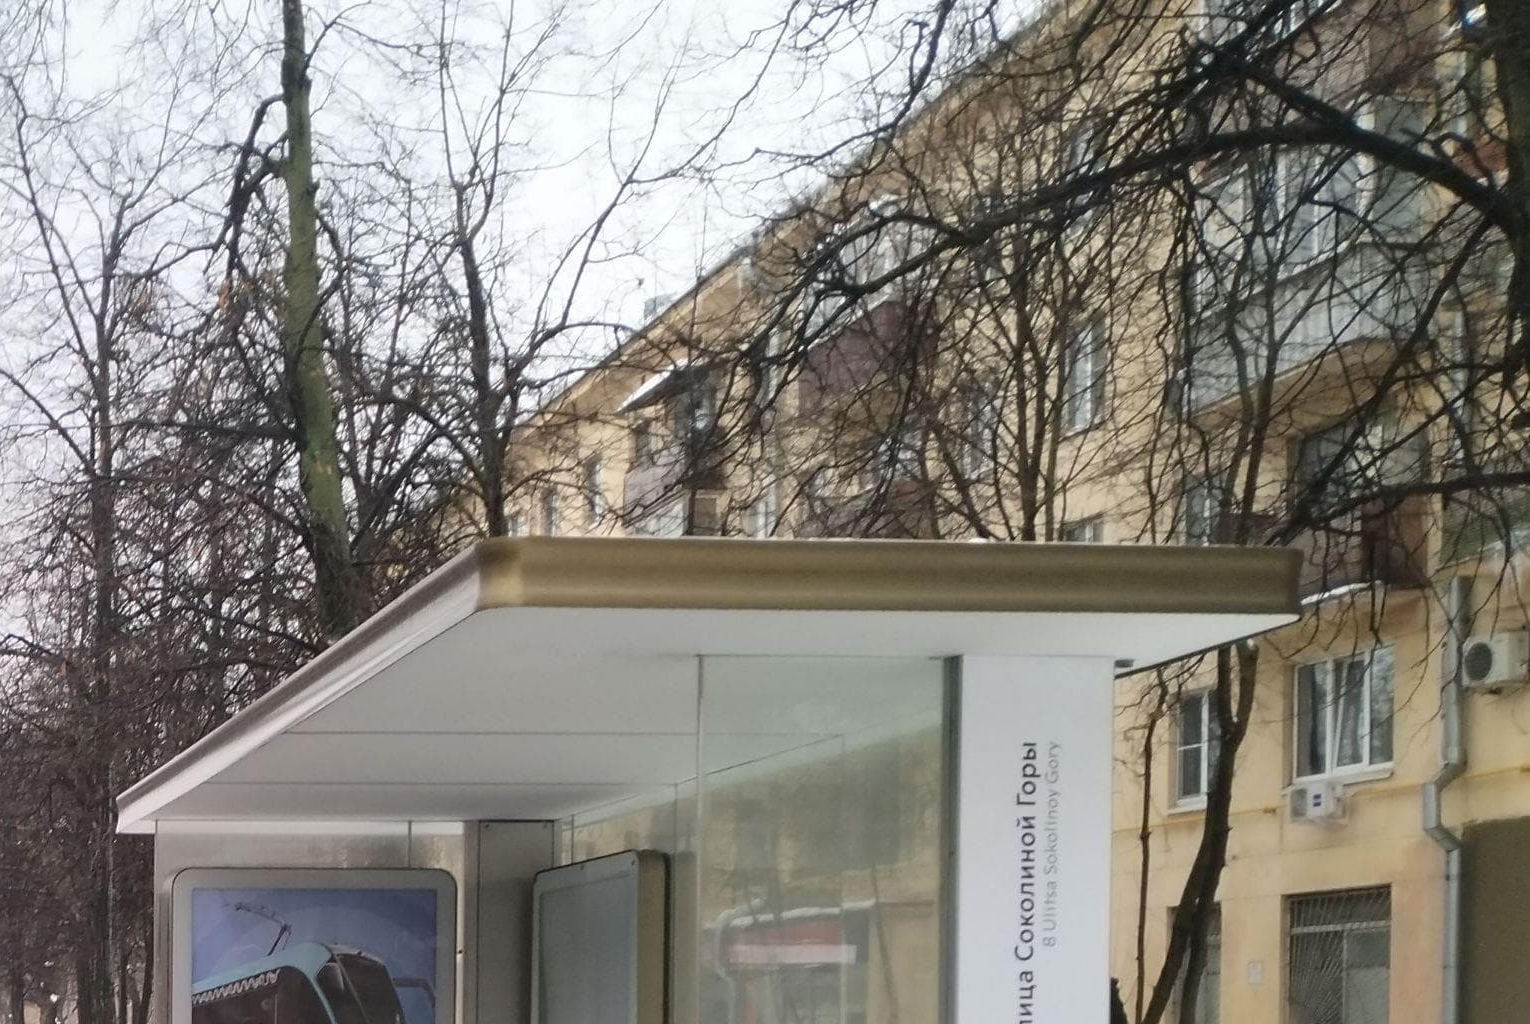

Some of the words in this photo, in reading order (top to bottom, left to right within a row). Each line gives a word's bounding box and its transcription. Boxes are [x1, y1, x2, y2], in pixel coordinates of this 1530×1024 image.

[1016, 742, 1042, 806] Горы
[1044, 741, 1062, 785] Gory
[1043, 788, 1062, 875] Sokolinoy
[1014, 815, 1037, 961] Соколиной
[1042, 880, 1058, 932] Ulitsa
[1042, 936, 1057, 948] 8
